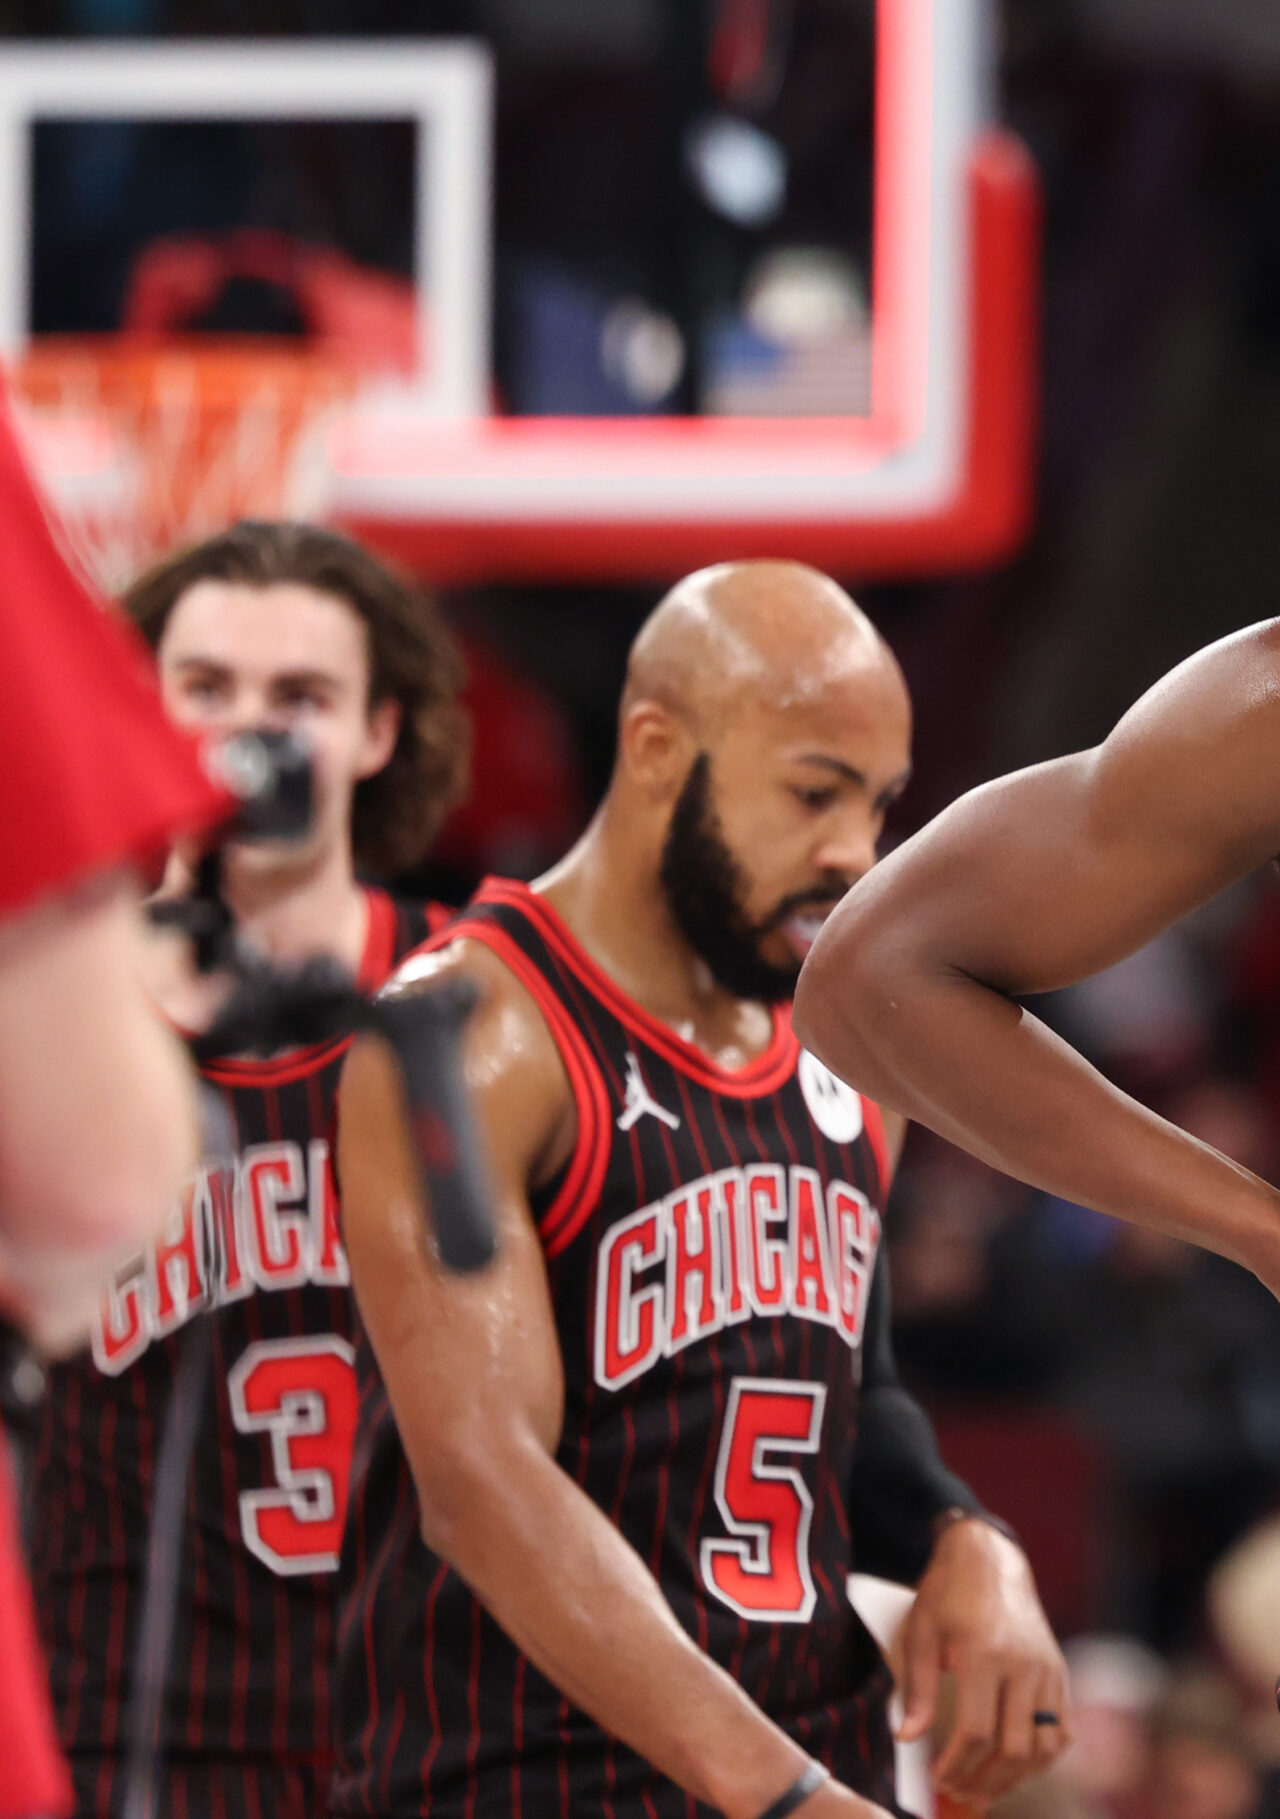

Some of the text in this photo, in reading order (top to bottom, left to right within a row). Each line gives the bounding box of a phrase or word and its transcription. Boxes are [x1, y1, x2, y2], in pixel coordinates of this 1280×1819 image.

[595, 1163, 883, 1391] CHICAG
[228, 1334, 358, 1576] 3
[701, 1377, 827, 1624] 5
